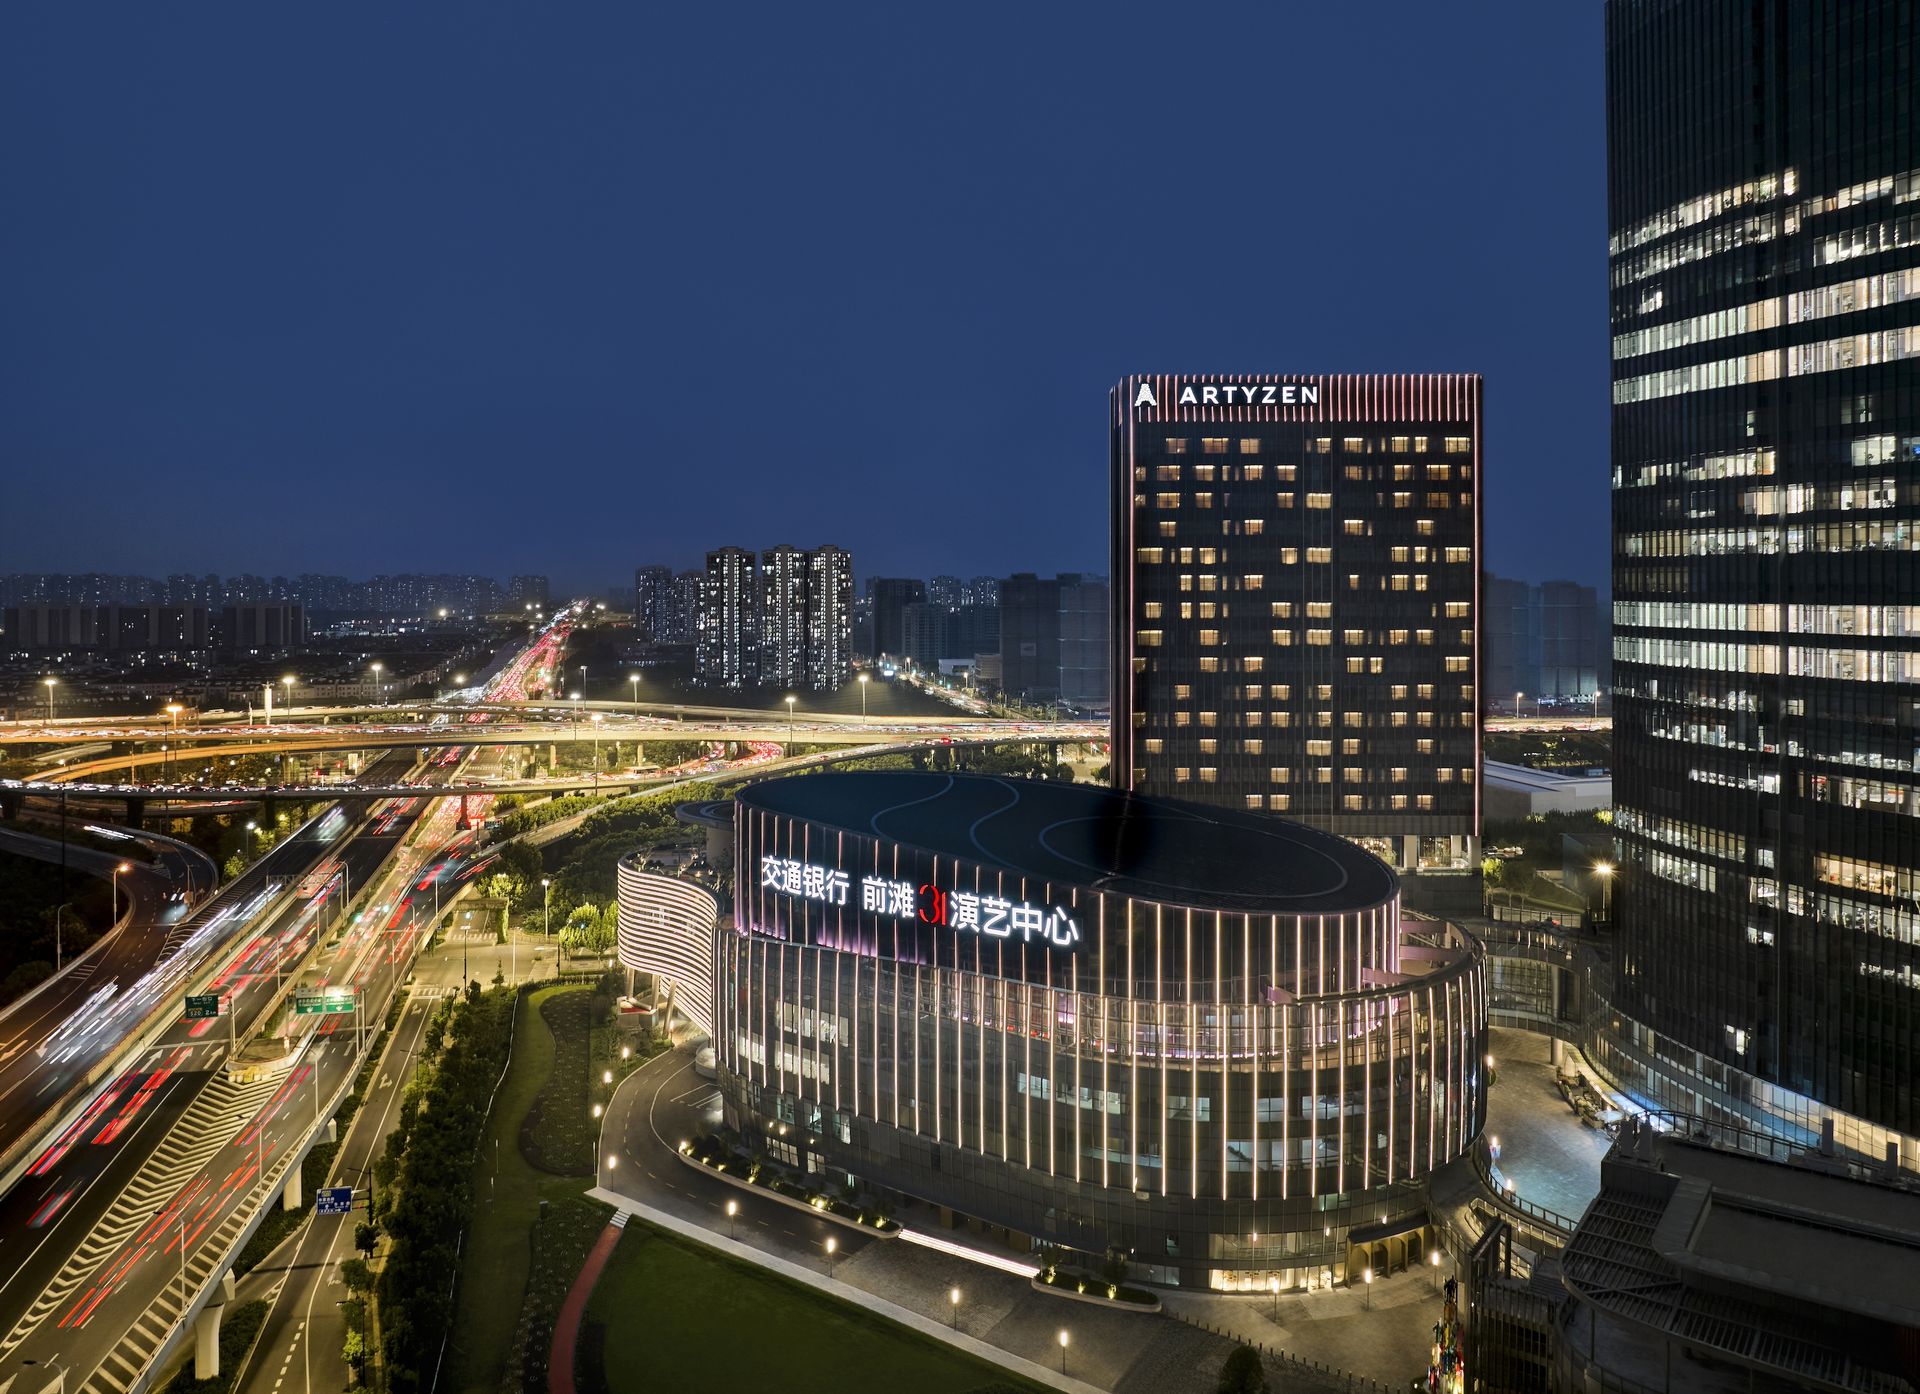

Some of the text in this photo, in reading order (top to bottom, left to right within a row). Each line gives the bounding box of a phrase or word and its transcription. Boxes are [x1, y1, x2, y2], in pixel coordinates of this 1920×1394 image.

[1179, 386, 1318, 404] ARTYZEN
[761, 855, 850, 906] 交通银行
